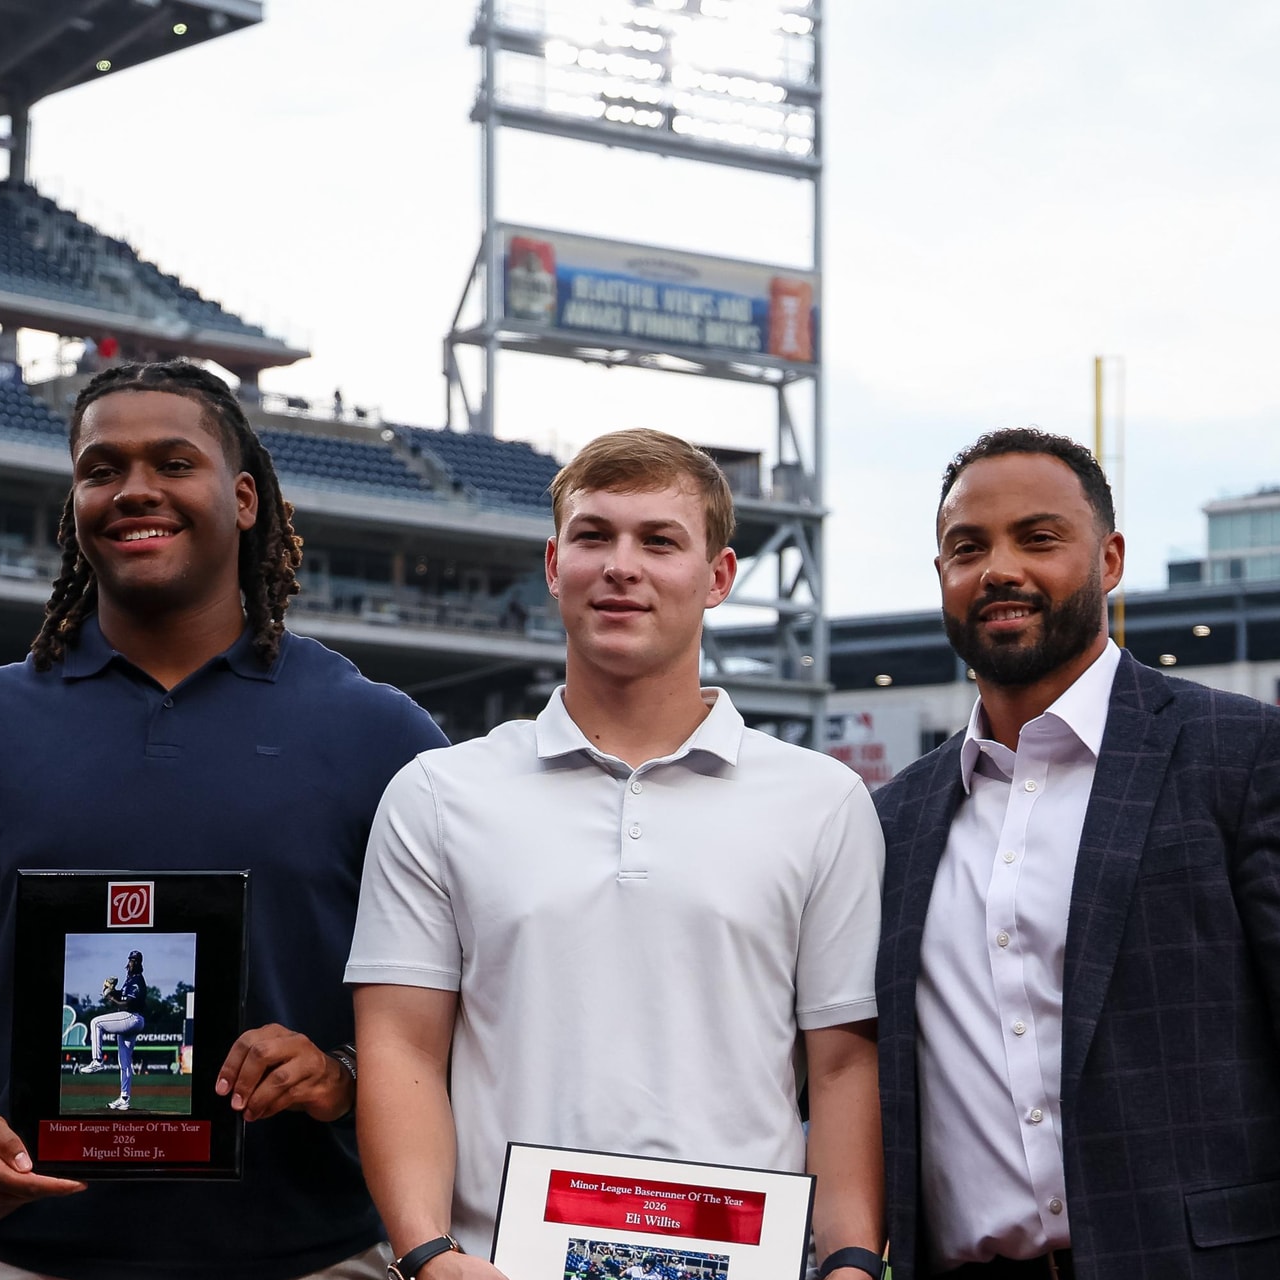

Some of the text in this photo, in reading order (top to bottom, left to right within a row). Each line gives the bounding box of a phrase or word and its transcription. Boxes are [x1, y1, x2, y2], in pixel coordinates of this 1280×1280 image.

[49, 1122, 200, 1134] Minor League Pitcher Of The Year
[113, 1135, 136, 1144] 2026
[82, 1147, 166, 1160] Miguel Sime Jr.
[570, 1179, 744, 1207] Minor League Baserunner Of The Year
[642, 1200, 667, 1212] 2026
[625, 1212, 681, 1229] Eli Willits
